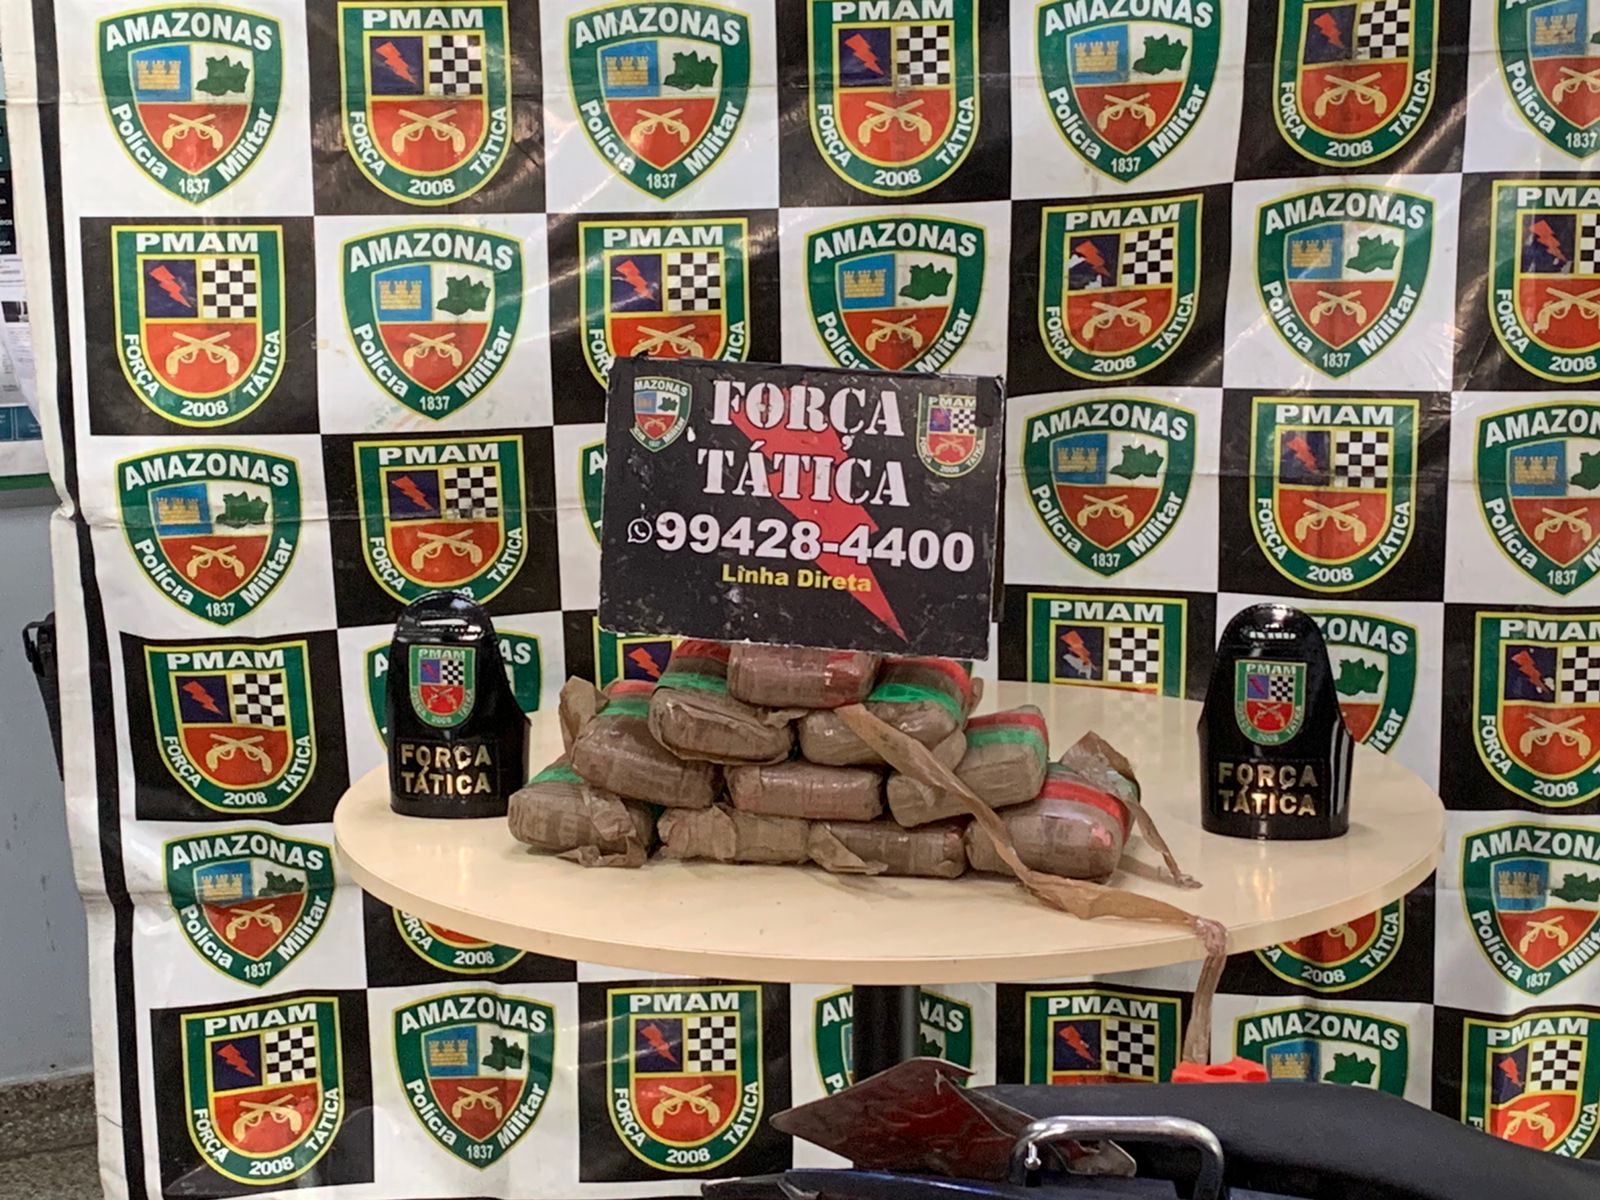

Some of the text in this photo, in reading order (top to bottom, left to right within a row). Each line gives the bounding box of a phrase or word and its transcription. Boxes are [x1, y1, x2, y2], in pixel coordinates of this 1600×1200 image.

[363, 9, 483, 29] PMAM
[576, 7, 740, 48] AMAZONAS
[833, 0, 953, 21] PMAM
[1046, 0, 1213, 36] AMAZONAS
[107, 12, 272, 51] AMAZONAS
[1281, 82, 1307, 139] FORÇA
[1389, 69, 1431, 136] TÁTICA
[1506, 60, 1556, 134] Polícia
[112, 103, 168, 179] Polícia
[469, 106, 507, 176] TÁTICA
[581, 100, 635, 174] Polícia
[683, 101, 739, 175] Militar
[818, 104, 851, 167] FORÇA
[936, 97, 974, 166] TÁTICA
[1049, 87, 1101, 160] Polícia
[1149, 84, 1207, 160] Militar
[216, 108, 272, 182] Militar
[350, 112, 386, 176] FORÇA
[1326, 140, 1373, 158] 2008
[647, 174, 677, 188] 1837
[873, 169, 921, 186] 2008
[1110, 157, 1141, 173] 1837
[178, 177, 210, 194] 1837
[408, 178, 455, 195] 2008
[1517, 187, 1600, 207] PMA
[1065, 203, 1180, 230] PMAM
[1266, 191, 1425, 234] AMAZONAS
[136, 233, 258, 252] PMAM
[351, 233, 513, 272] AMAZONAS
[604, 227, 723, 248] PMAM
[815, 223, 976, 263] AMAZONAS
[1046, 306, 1074, 360] FORÇA
[1151, 293, 1194, 353] TÁTICA
[1263, 281, 1313, 353] Polícia
[1358, 284, 1417, 357] Militar
[1497, 290, 1529, 361] FORÇA
[353, 323, 408, 397] Polícia
[722, 321, 745, 362] TICA
[915, 308, 972, 373] Militar
[1322, 352, 1351, 368] 1837
[125, 334, 160, 398] FORÇA
[242, 331, 278, 397] TÁTICA
[456, 326, 512, 397] Militar
[1091, 355, 1138, 373] 2008
[1549, 356, 1596, 372] 2008
[420, 396, 449, 410] 1837
[634, 380, 688, 397] MAZONAS
[928, 396, 976, 407] PMAM
[180, 400, 228, 417] 2008
[710, 378, 905, 451] FORÇA
[1033, 404, 1188, 442] AMAZONAS
[1276, 405, 1394, 425] PMAM
[1485, 409, 1600, 448] AMAZO
[126, 453, 288, 490] AMAZONAS
[379, 444, 498, 464] PMAM
[697, 440, 911, 508] TÁTICA
[1033, 485, 1083, 554] Polícia
[1127, 491, 1182, 557] Militar
[1258, 497, 1287, 560] FORÇA
[1369, 501, 1410, 566] TÁTICA
[1486, 498, 1537, 568] Polícia
[486, 528, 523, 583] TÁTICA
[655, 511, 975, 572] 99428-4400
[1091, 553, 1121, 568] 1837
[135, 539, 193, 604] Polícia
[240, 538, 292, 606] Militar
[370, 537, 406, 592] FORÇA
[722, 563, 872, 594] Linha Direta
[1306, 565, 1353, 584] 2008
[1548, 570, 1577, 584] 1837
[206, 603, 234, 616] 1837
[1051, 601, 1163, 623] PMAM
[1500, 619, 1600, 641] PMA
[167, 650, 284, 669] PMAM
[418, 649, 466, 660] PMAM
[1246, 664, 1296, 675] PMAM
[163, 736, 202, 788] FORÇA
[277, 735, 310, 793] TÁTICA
[401, 743, 492, 770] FORÇA
[1481, 715, 1513, 775] FORÇA
[401, 766, 492, 795] TÁTICA
[1218, 762, 1318, 790] FORÇA
[1533, 781, 1578, 797] 2008
[222, 790, 268, 805] 2008
[1218, 785, 1316, 816] TÁTICA
[173, 835, 323, 870] AMAZONAS
[1471, 830, 1600, 861] AMAZON
[181, 905, 232, 968] Polícia
[278, 896, 326, 960] Militar
[402, 911, 433, 951] RÇA
[1359, 912, 1398, 967] TÁTICA
[1472, 910, 1523, 981] Polícia
[245, 962, 271, 978] 1837
[453, 951, 495, 965] 2008
[1302, 965, 1346, 984] 2008
[1527, 973, 1551, 988] 1837
[204, 1003, 317, 1036] PMAM
[402, 997, 546, 1034] AMAZONAS
[630, 993, 738, 1012] PMAM
[1049, 997, 1157, 1018] PMAM
[1243, 1009, 1399, 1050] AMAZONAS
[1487, 1018, 1589, 1045] PMAM
[305, 1087, 339, 1153] TÁTICA
[407, 1079, 456, 1145] Polícia
[497, 1083, 544, 1148] Militar
[616, 1088, 645, 1146] FORÇA
[723, 1082, 755, 1144] TÁTICA
[193, 1108, 230, 1163] FORÇA
[467, 1145, 493, 1158] 1837
[249, 1156, 294, 1175] 2008
[666, 1148, 710, 1163] 2008
